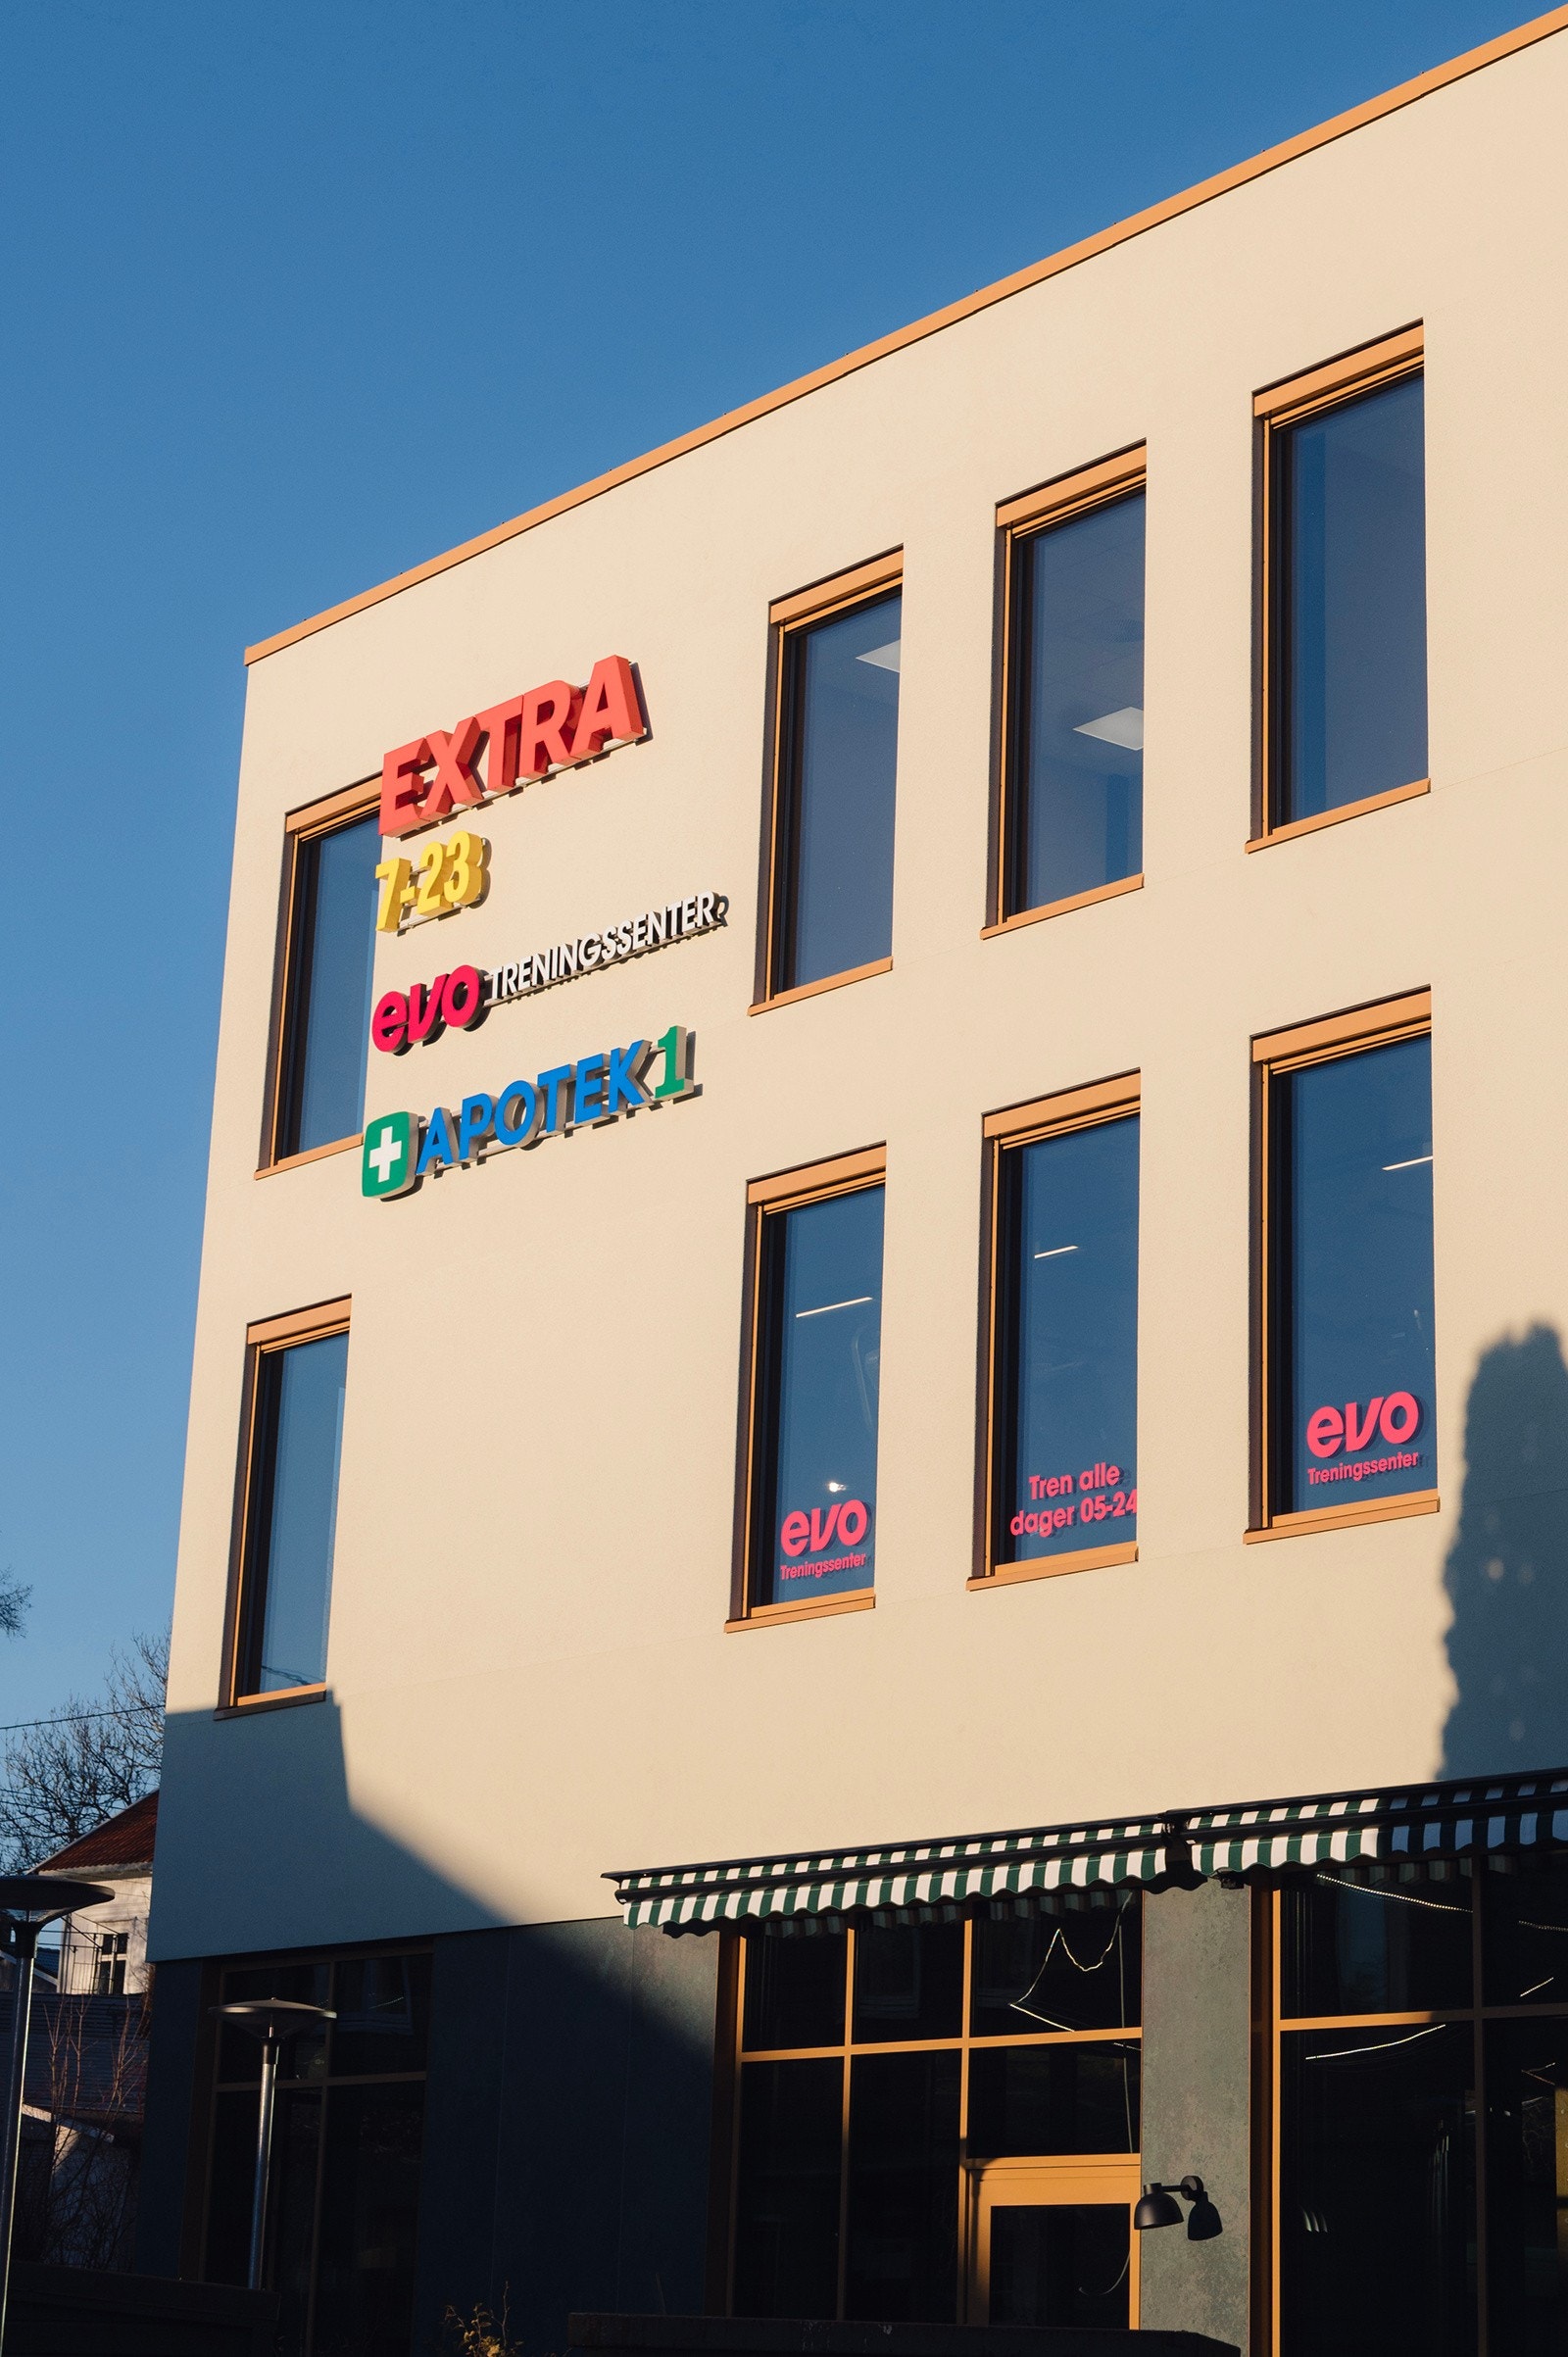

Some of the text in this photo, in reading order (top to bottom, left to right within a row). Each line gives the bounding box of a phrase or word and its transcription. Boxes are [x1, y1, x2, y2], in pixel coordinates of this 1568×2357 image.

[379, 655, 647, 837] EXTRA
[375, 831, 486, 932] 7-23
[372, 890, 716, 1053] evo TRENINGSSENTER
[416, 1039, 649, 1175] APOTEK
[1306, 1391, 1419, 1458] evo
[1028, 1461, 1120, 1500] Tren alle
[1307, 1451, 1419, 1485] Treningssenter
[780, 1498, 868, 1557] evo
[1009, 1488, 1137, 1538] dager 05-24
[780, 1552, 866, 1580] Treningssenter
